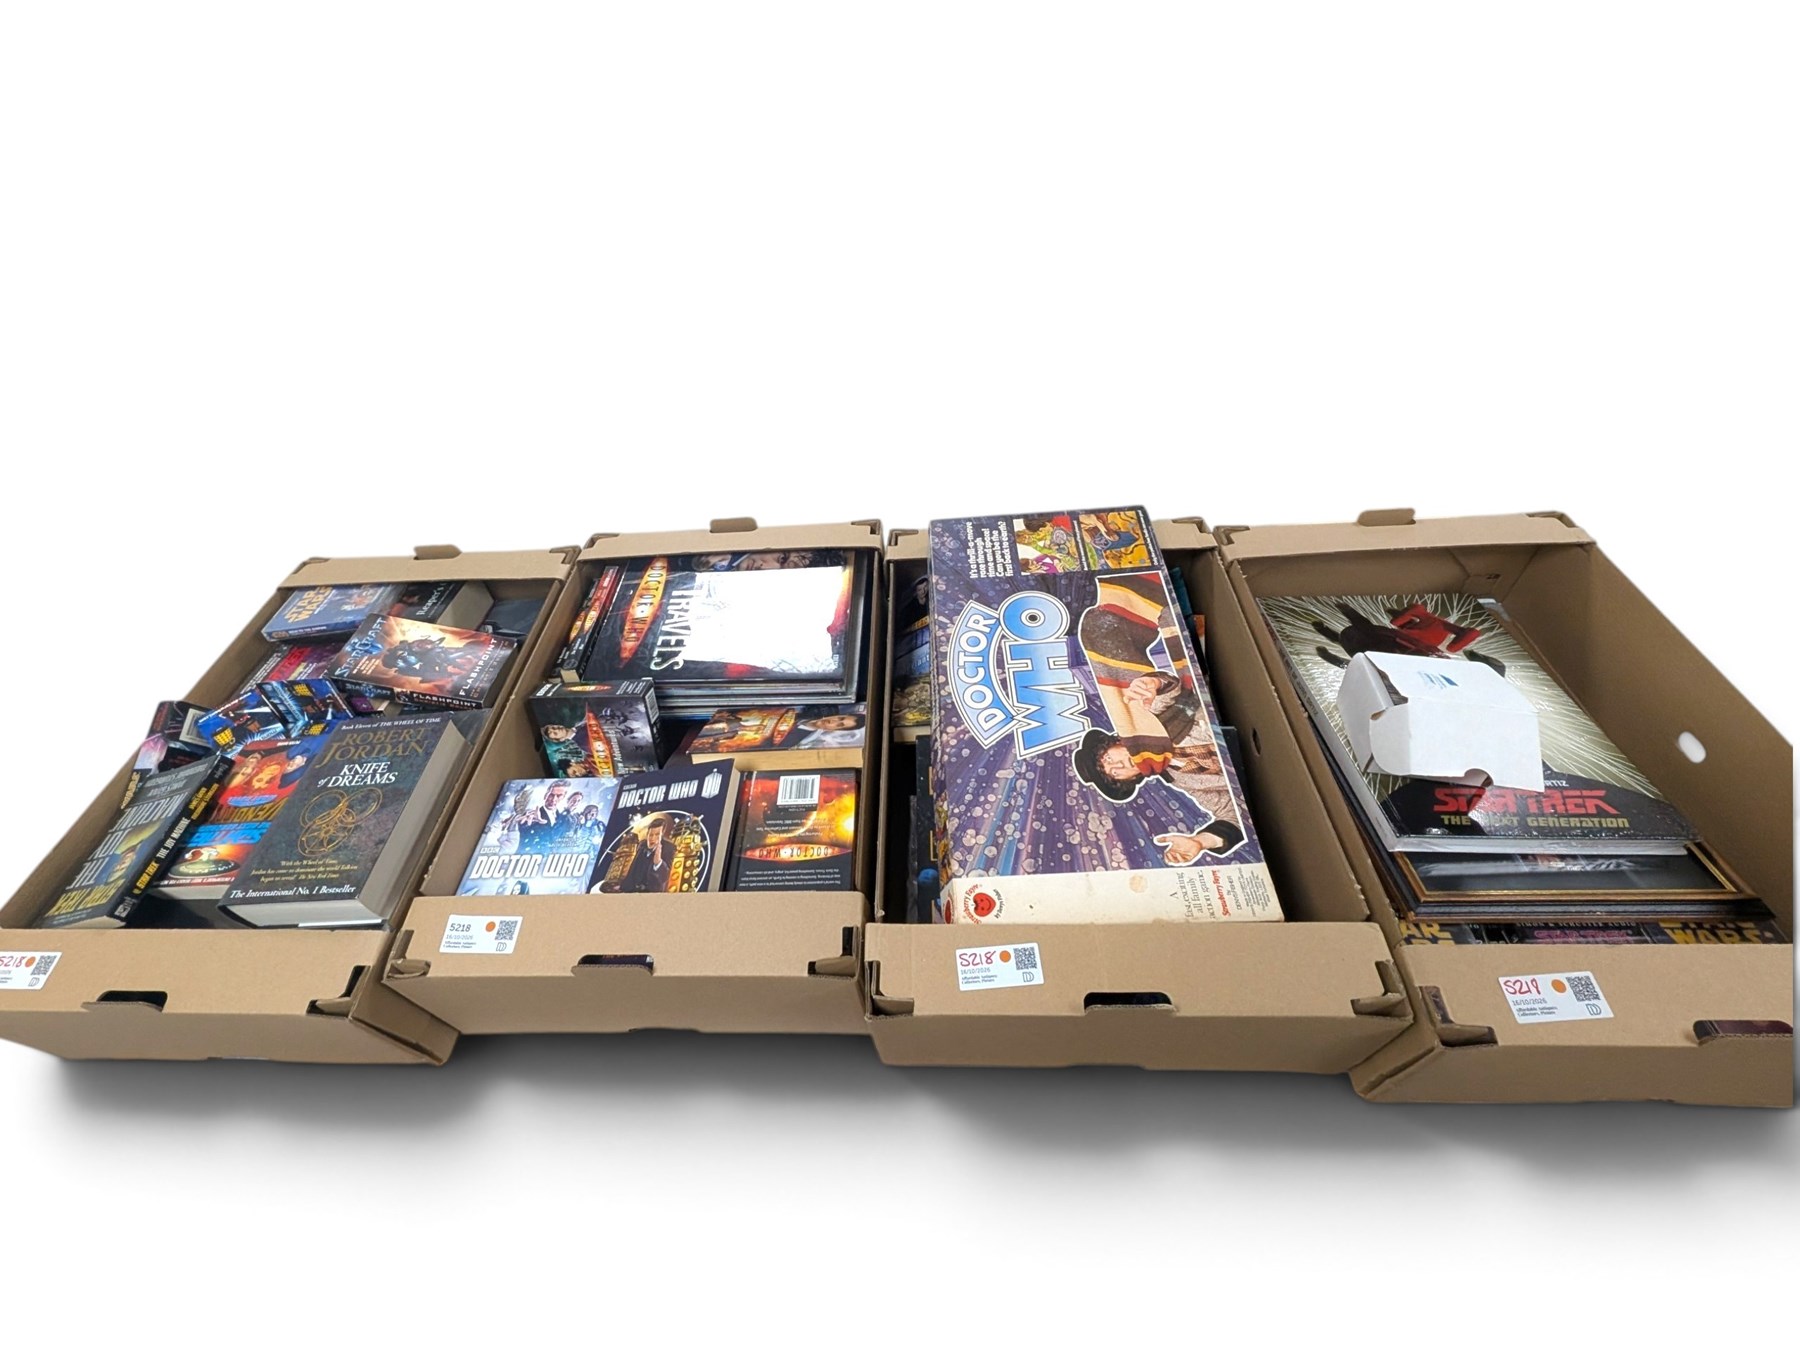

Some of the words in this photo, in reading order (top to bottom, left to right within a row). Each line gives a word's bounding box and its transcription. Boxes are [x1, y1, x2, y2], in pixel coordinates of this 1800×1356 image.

[981, 528, 993, 548] space!
[991, 530, 1000, 541] the
[998, 521, 1009, 541] earth?
[966, 521, 977, 564] thrill-a-move
[974, 537, 985, 564] through
[992, 541, 1001, 551] be
[1002, 541, 1009, 549] to
[984, 549, 994, 562] and
[995, 550, 1005, 563] you
[1002, 549, 1012, 564] back
[979, 563, 987, 578] race
[987, 562, 996, 578] time
[996, 563, 1005, 577] Can
[1005, 563, 1014, 577] first
[636, 565, 666, 607] DOCTOR
[284, 587, 321, 619] STAR
[459, 638, 497, 696] FLASHPOINT
[956, 613, 1007, 731] DOCTOR
[1001, 593, 1090, 754] WHO
[412, 693, 477, 707] FLASHPOINT
[340, 727, 432, 746] ROBERT
[315, 740, 432, 768] JORDAN
[595, 749, 612, 776] OCTOR
[339, 761, 391, 776] KNIFE
[317, 777, 331, 788] of
[327, 772, 398, 787] DREAMS
[1544, 780, 1569, 788] RTIZ
[617, 785, 667, 809] DOCTOR
[668, 780, 699, 801] WHO
[1433, 787, 1518, 813] STAR
[1519, 789, 1621, 815] TREK
[108, 792, 188, 832] MACHINE
[1441, 815, 1472, 826] THE
[1482, 816, 1520, 827] EXT
[1527, 816, 1630, 829] GENERATION
[87, 828, 133, 860] JOY
[136, 874, 151, 889] STAR
[146, 860, 160, 878] TREK
[156, 847, 169, 859] THE
[164, 839, 176, 851] JOY
[171, 817, 191, 841] MACHINE
[759, 848, 781, 859] WHO
[790, 846, 829, 858] DOCTOR
[65, 857, 110, 890] THE
[469, 854, 543, 879] DOCTOR
[543, 853, 590, 878] WHO
[1197, 869, 1210, 894] game.
[1211, 869, 1220, 885] Fayre
[230, 890, 244, 898] The
[246, 887, 295, 897] International
[296, 886, 310, 895] No.
[319, 885, 356, 894] Bestseller
[1170, 891, 1179, 899] A
[1186, 877, 1200, 902] family
[1193, 903, 1203, 914] all
[1203, 894, 1216, 919] action
[1216, 884, 1231, 917] Strawberry
[449, 923, 472, 932] 5218
